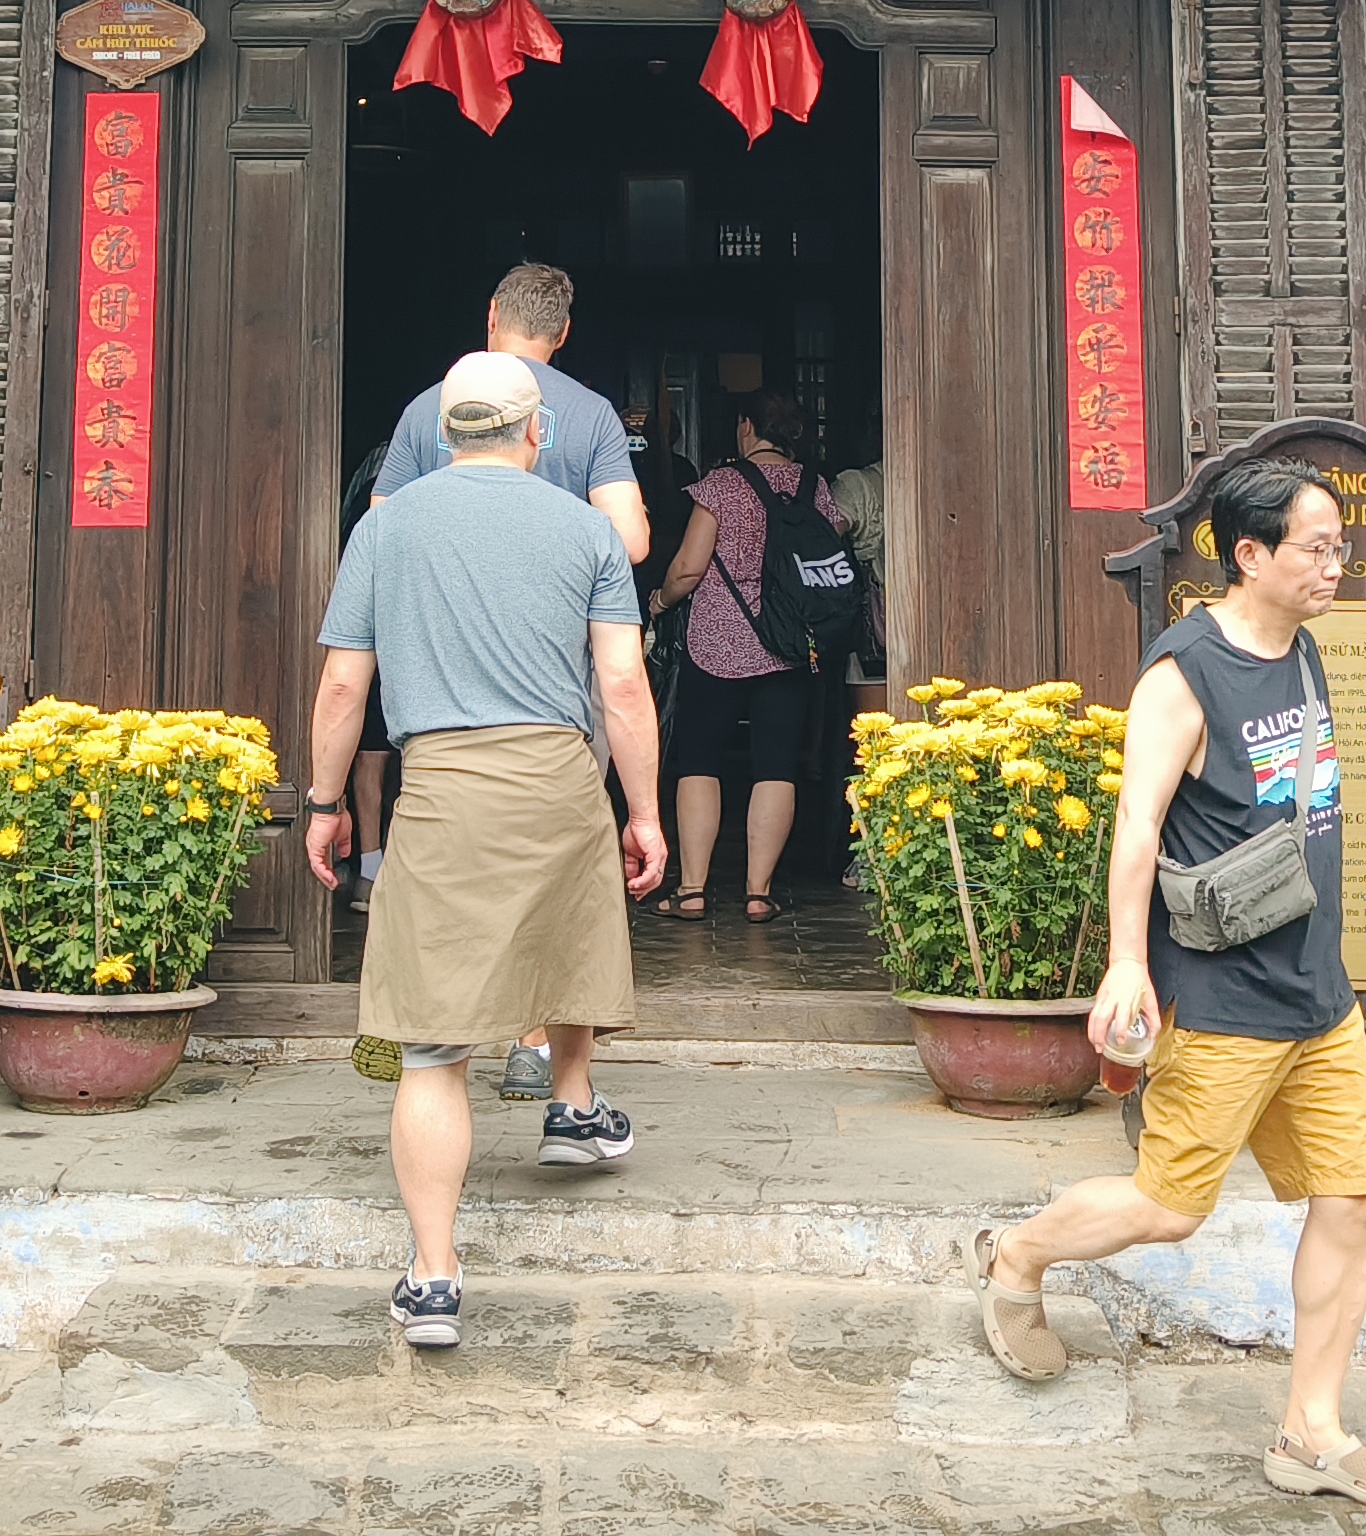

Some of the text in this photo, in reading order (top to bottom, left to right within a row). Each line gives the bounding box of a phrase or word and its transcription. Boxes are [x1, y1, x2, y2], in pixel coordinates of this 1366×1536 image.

[1073, 132, 1127, 491] 安竹報平安福
[793, 551, 855, 588] VANS
[1346, 909, 1359, 917] the
